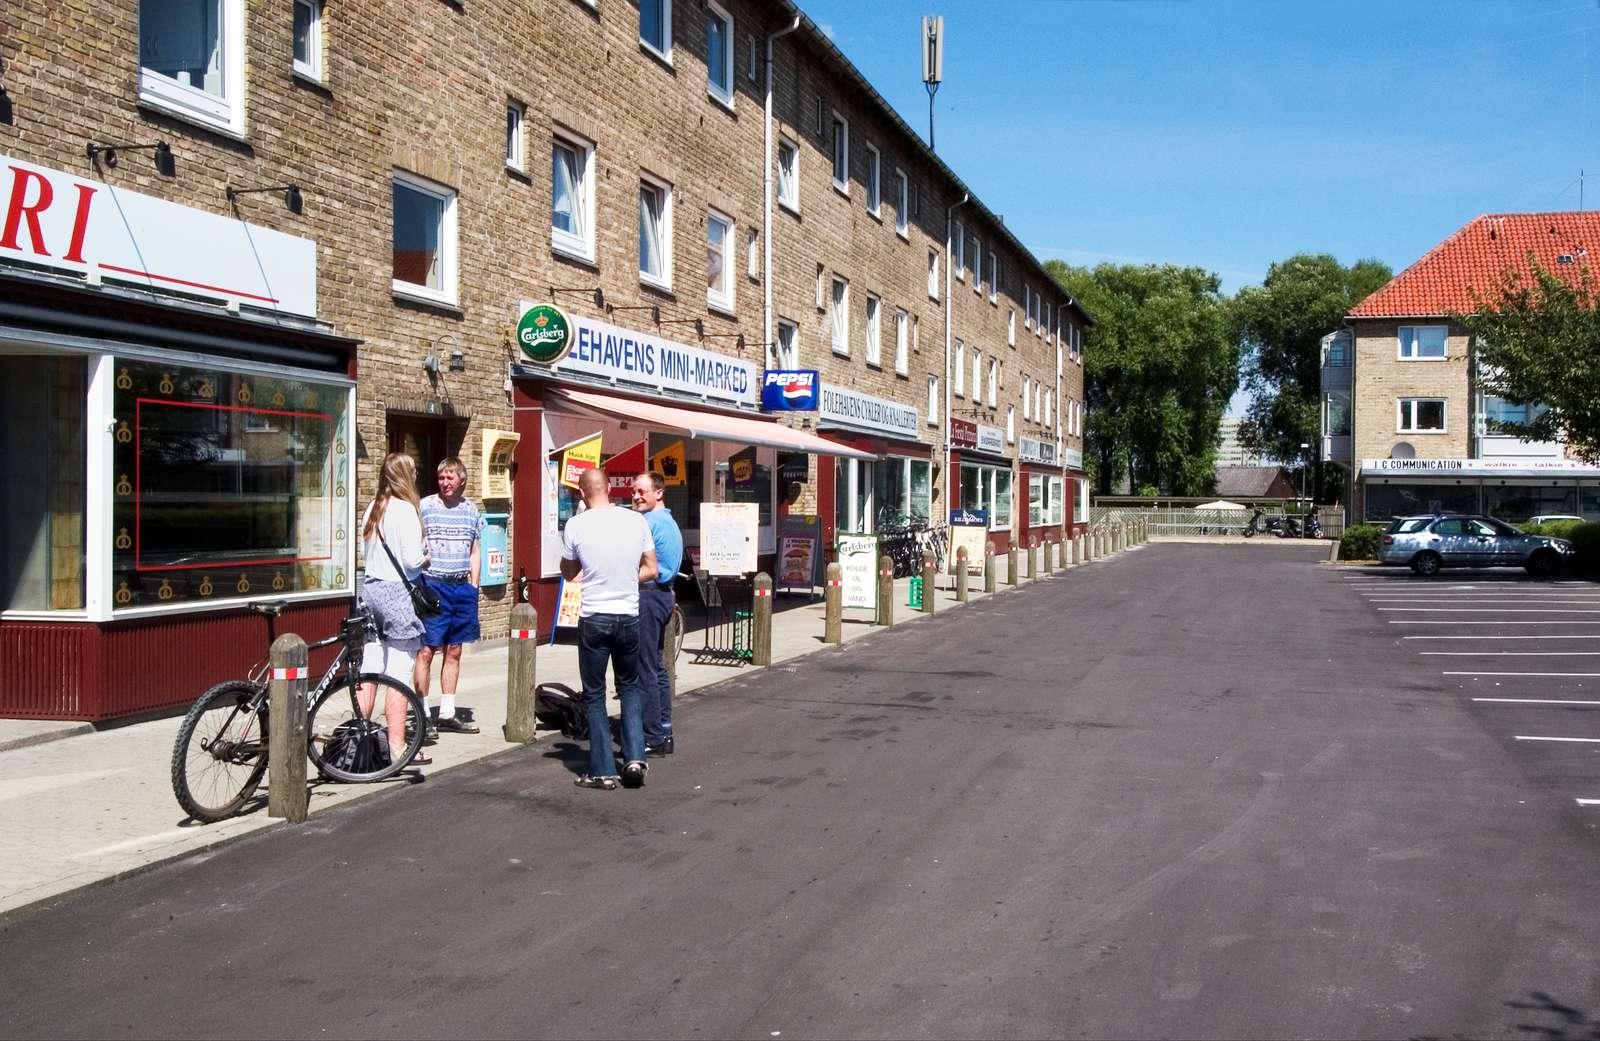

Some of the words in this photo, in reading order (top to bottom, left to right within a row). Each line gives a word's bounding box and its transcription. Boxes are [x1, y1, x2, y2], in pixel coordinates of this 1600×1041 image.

[0, 164, 98, 264] RI
[520, 325, 565, 345] Carlsberg
[660, 347, 748, 394] MINI-MARKED
[765, 372, 814, 387] PEPSI
[823, 390, 860, 418] FOLEHAVENS
[1390, 460, 1462, 470] COMMUNICATION
